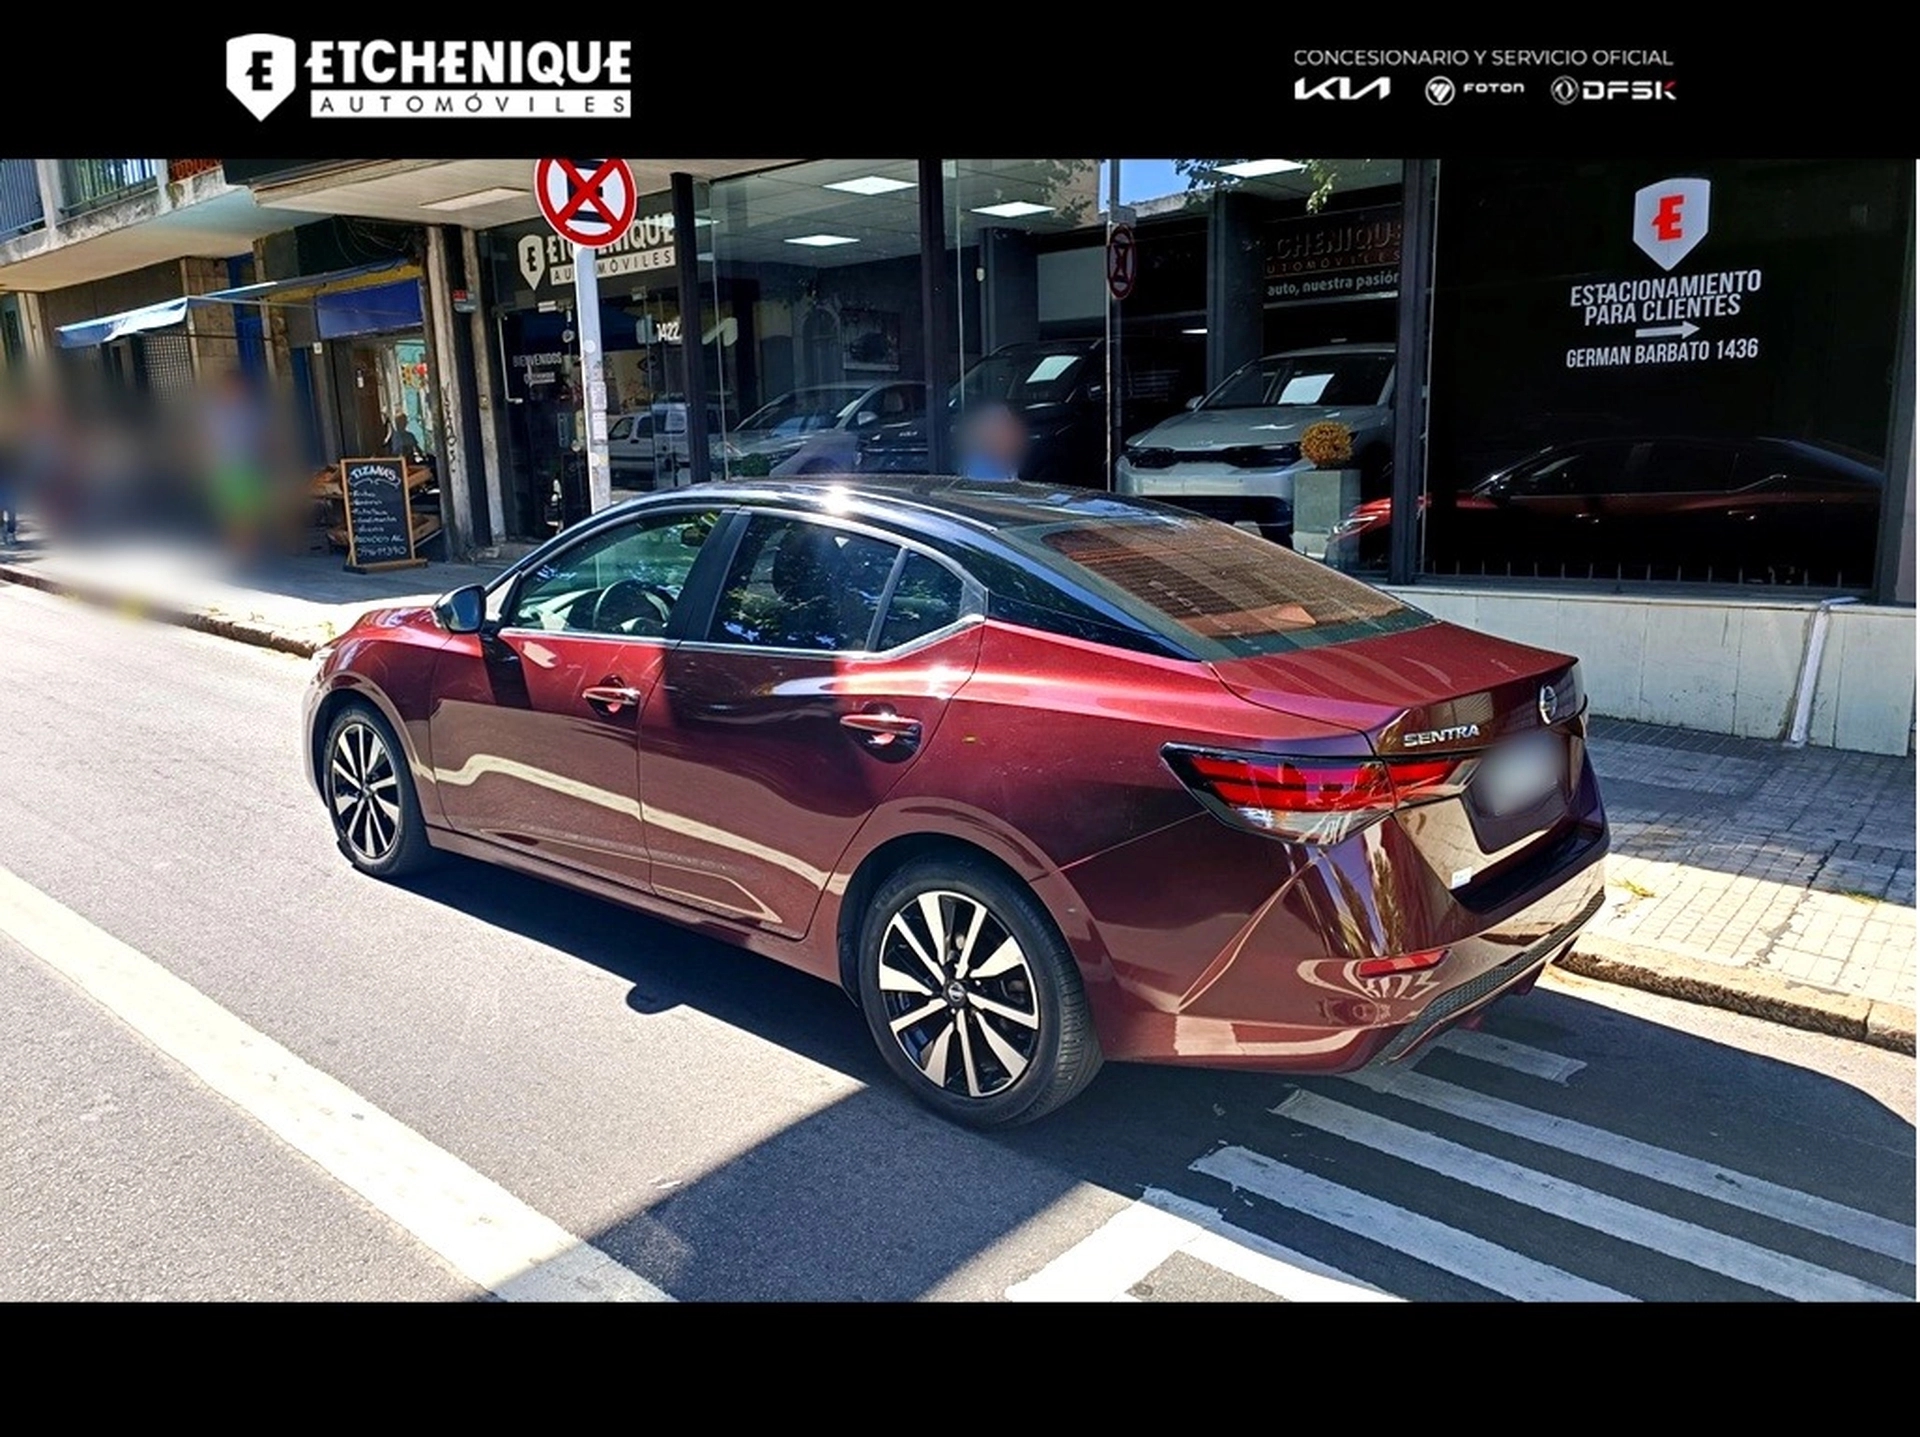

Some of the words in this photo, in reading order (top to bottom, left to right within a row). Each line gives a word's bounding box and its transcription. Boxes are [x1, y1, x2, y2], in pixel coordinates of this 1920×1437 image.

[553, 250, 672, 281] AUMÓVILES
[1267, 281, 1300, 296] auto,
[1302, 276, 1353, 293] nuestra
[1570, 269, 1762, 307] ESTACIONAMIENTO
[1585, 302, 1637, 326] PARA
[1642, 292, 1741, 322] CLIENTES
[1566, 345, 1631, 368] GERMAN
[1634, 341, 1710, 364] BARBATO
[1716, 338, 1759, 360] 1436
[1403, 724, 1480, 747] SENTRA
